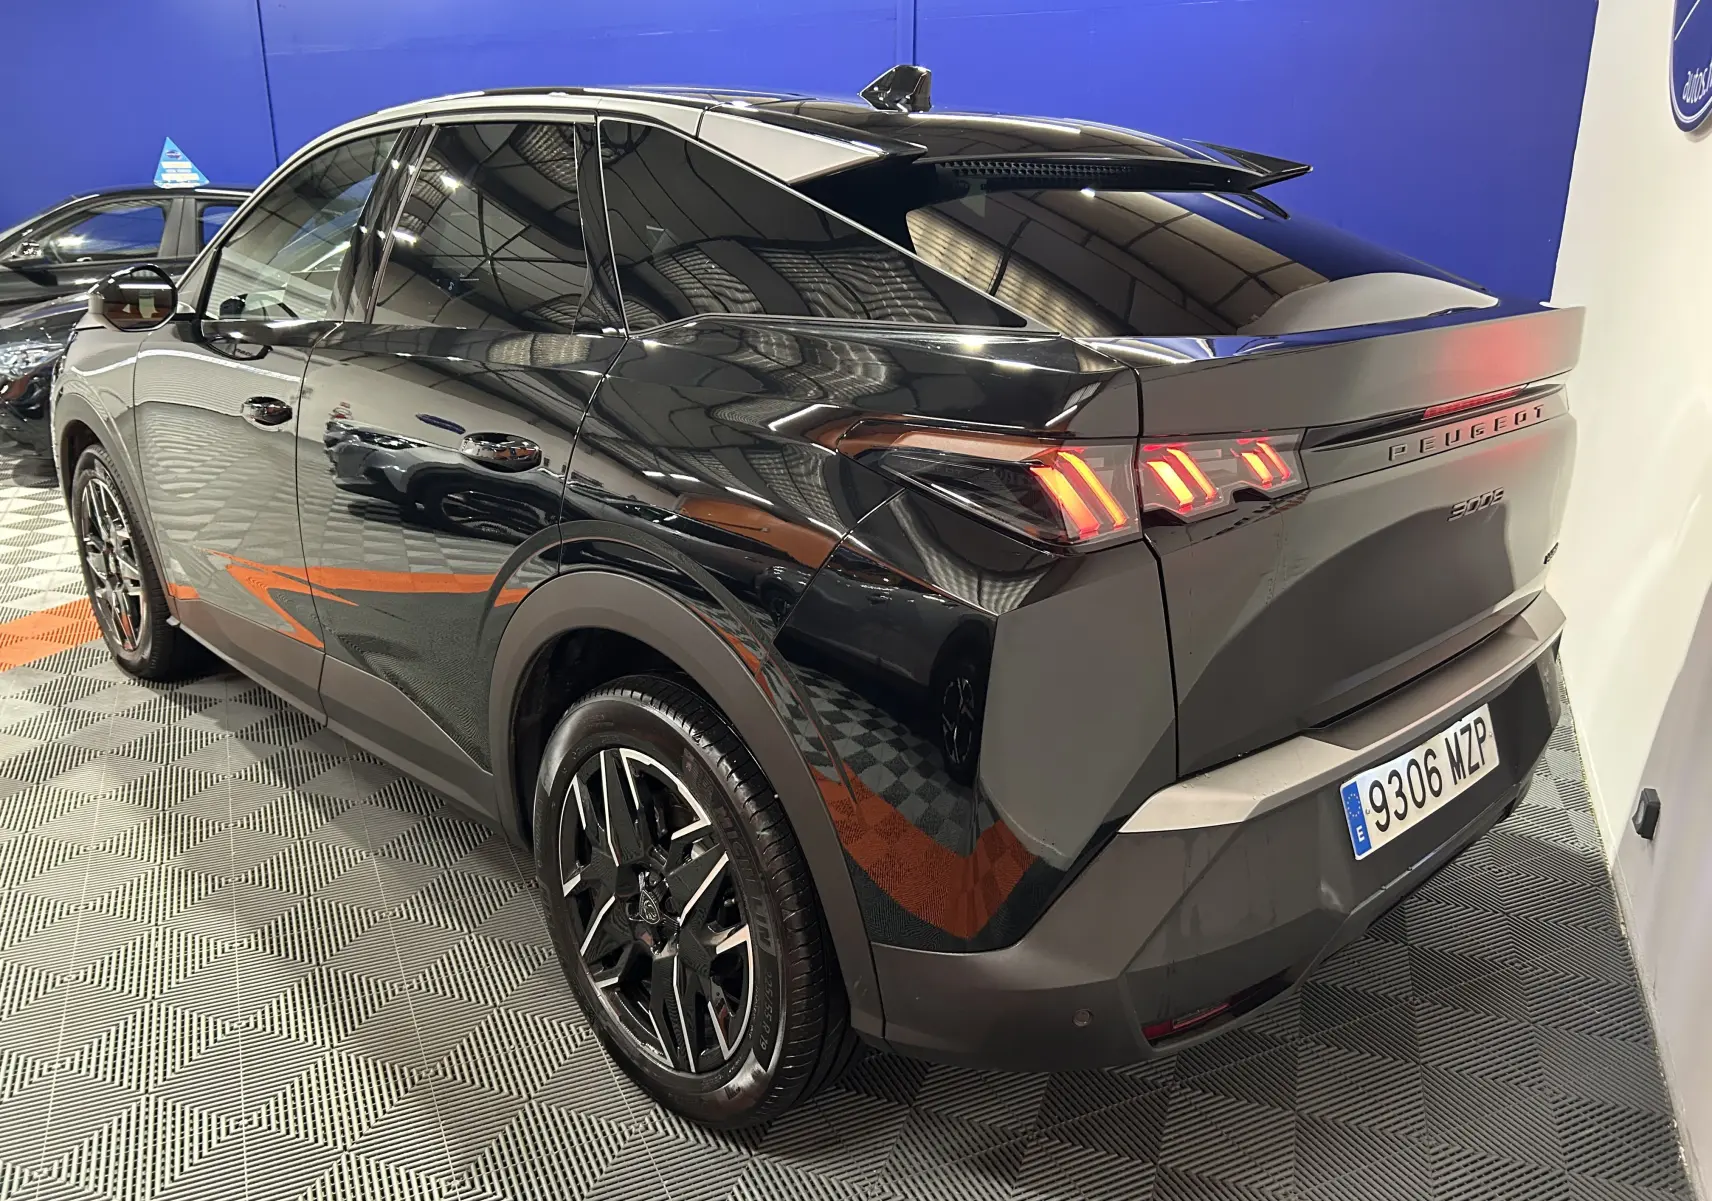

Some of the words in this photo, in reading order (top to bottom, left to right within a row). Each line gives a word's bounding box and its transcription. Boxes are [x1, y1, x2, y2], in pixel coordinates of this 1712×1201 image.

[1388, 404, 1544, 461] PEUGEOT
[1447, 487, 1504, 521] 3008
[1368, 748, 1443, 832] 9306
[1444, 716, 1487, 785] MZP
[1355, 825, 1365, 842] E
